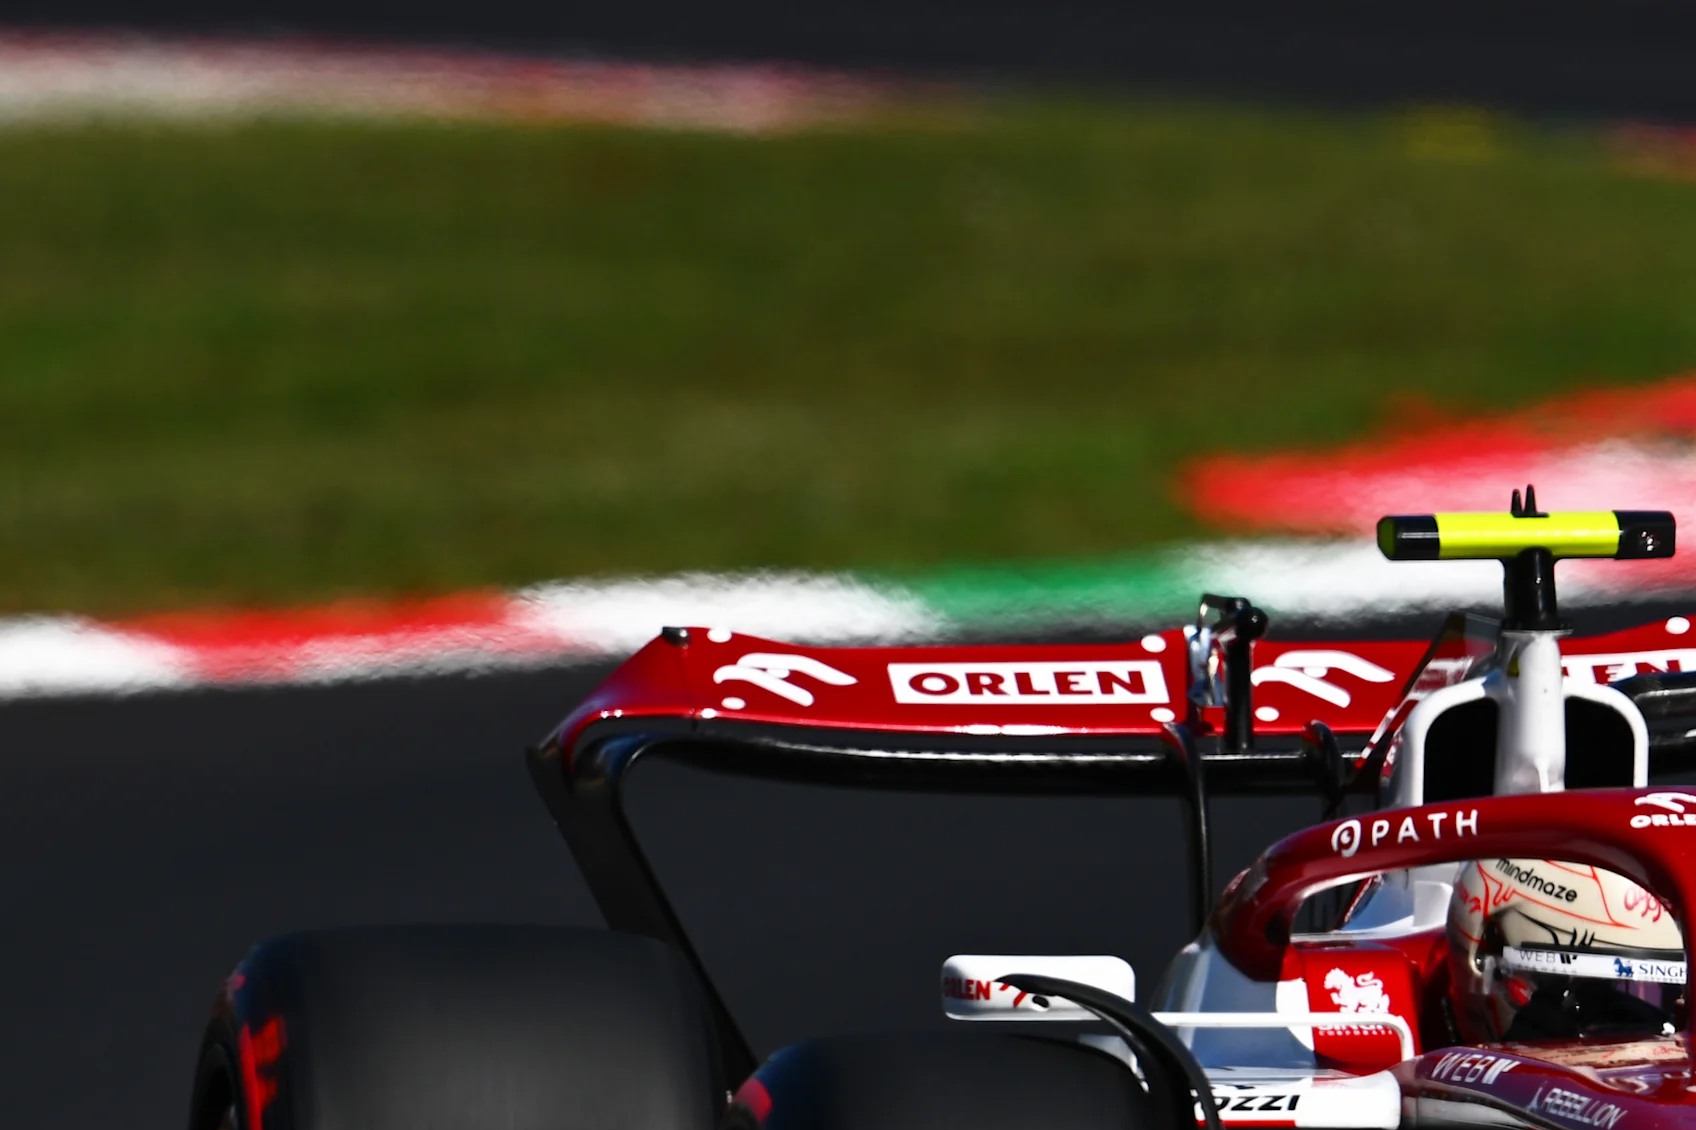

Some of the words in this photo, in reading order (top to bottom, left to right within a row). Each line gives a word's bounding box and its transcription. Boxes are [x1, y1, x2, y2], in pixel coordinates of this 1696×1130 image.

[907, 670, 1148, 698] ORLEN
[1371, 808, 1479, 847] PATH
[1495, 858, 1578, 903] mindmaze
[1638, 963, 1687, 978] SING
[1213, 1094, 1301, 1111] OZZI
[1542, 1087, 1629, 1130] REBELLION
